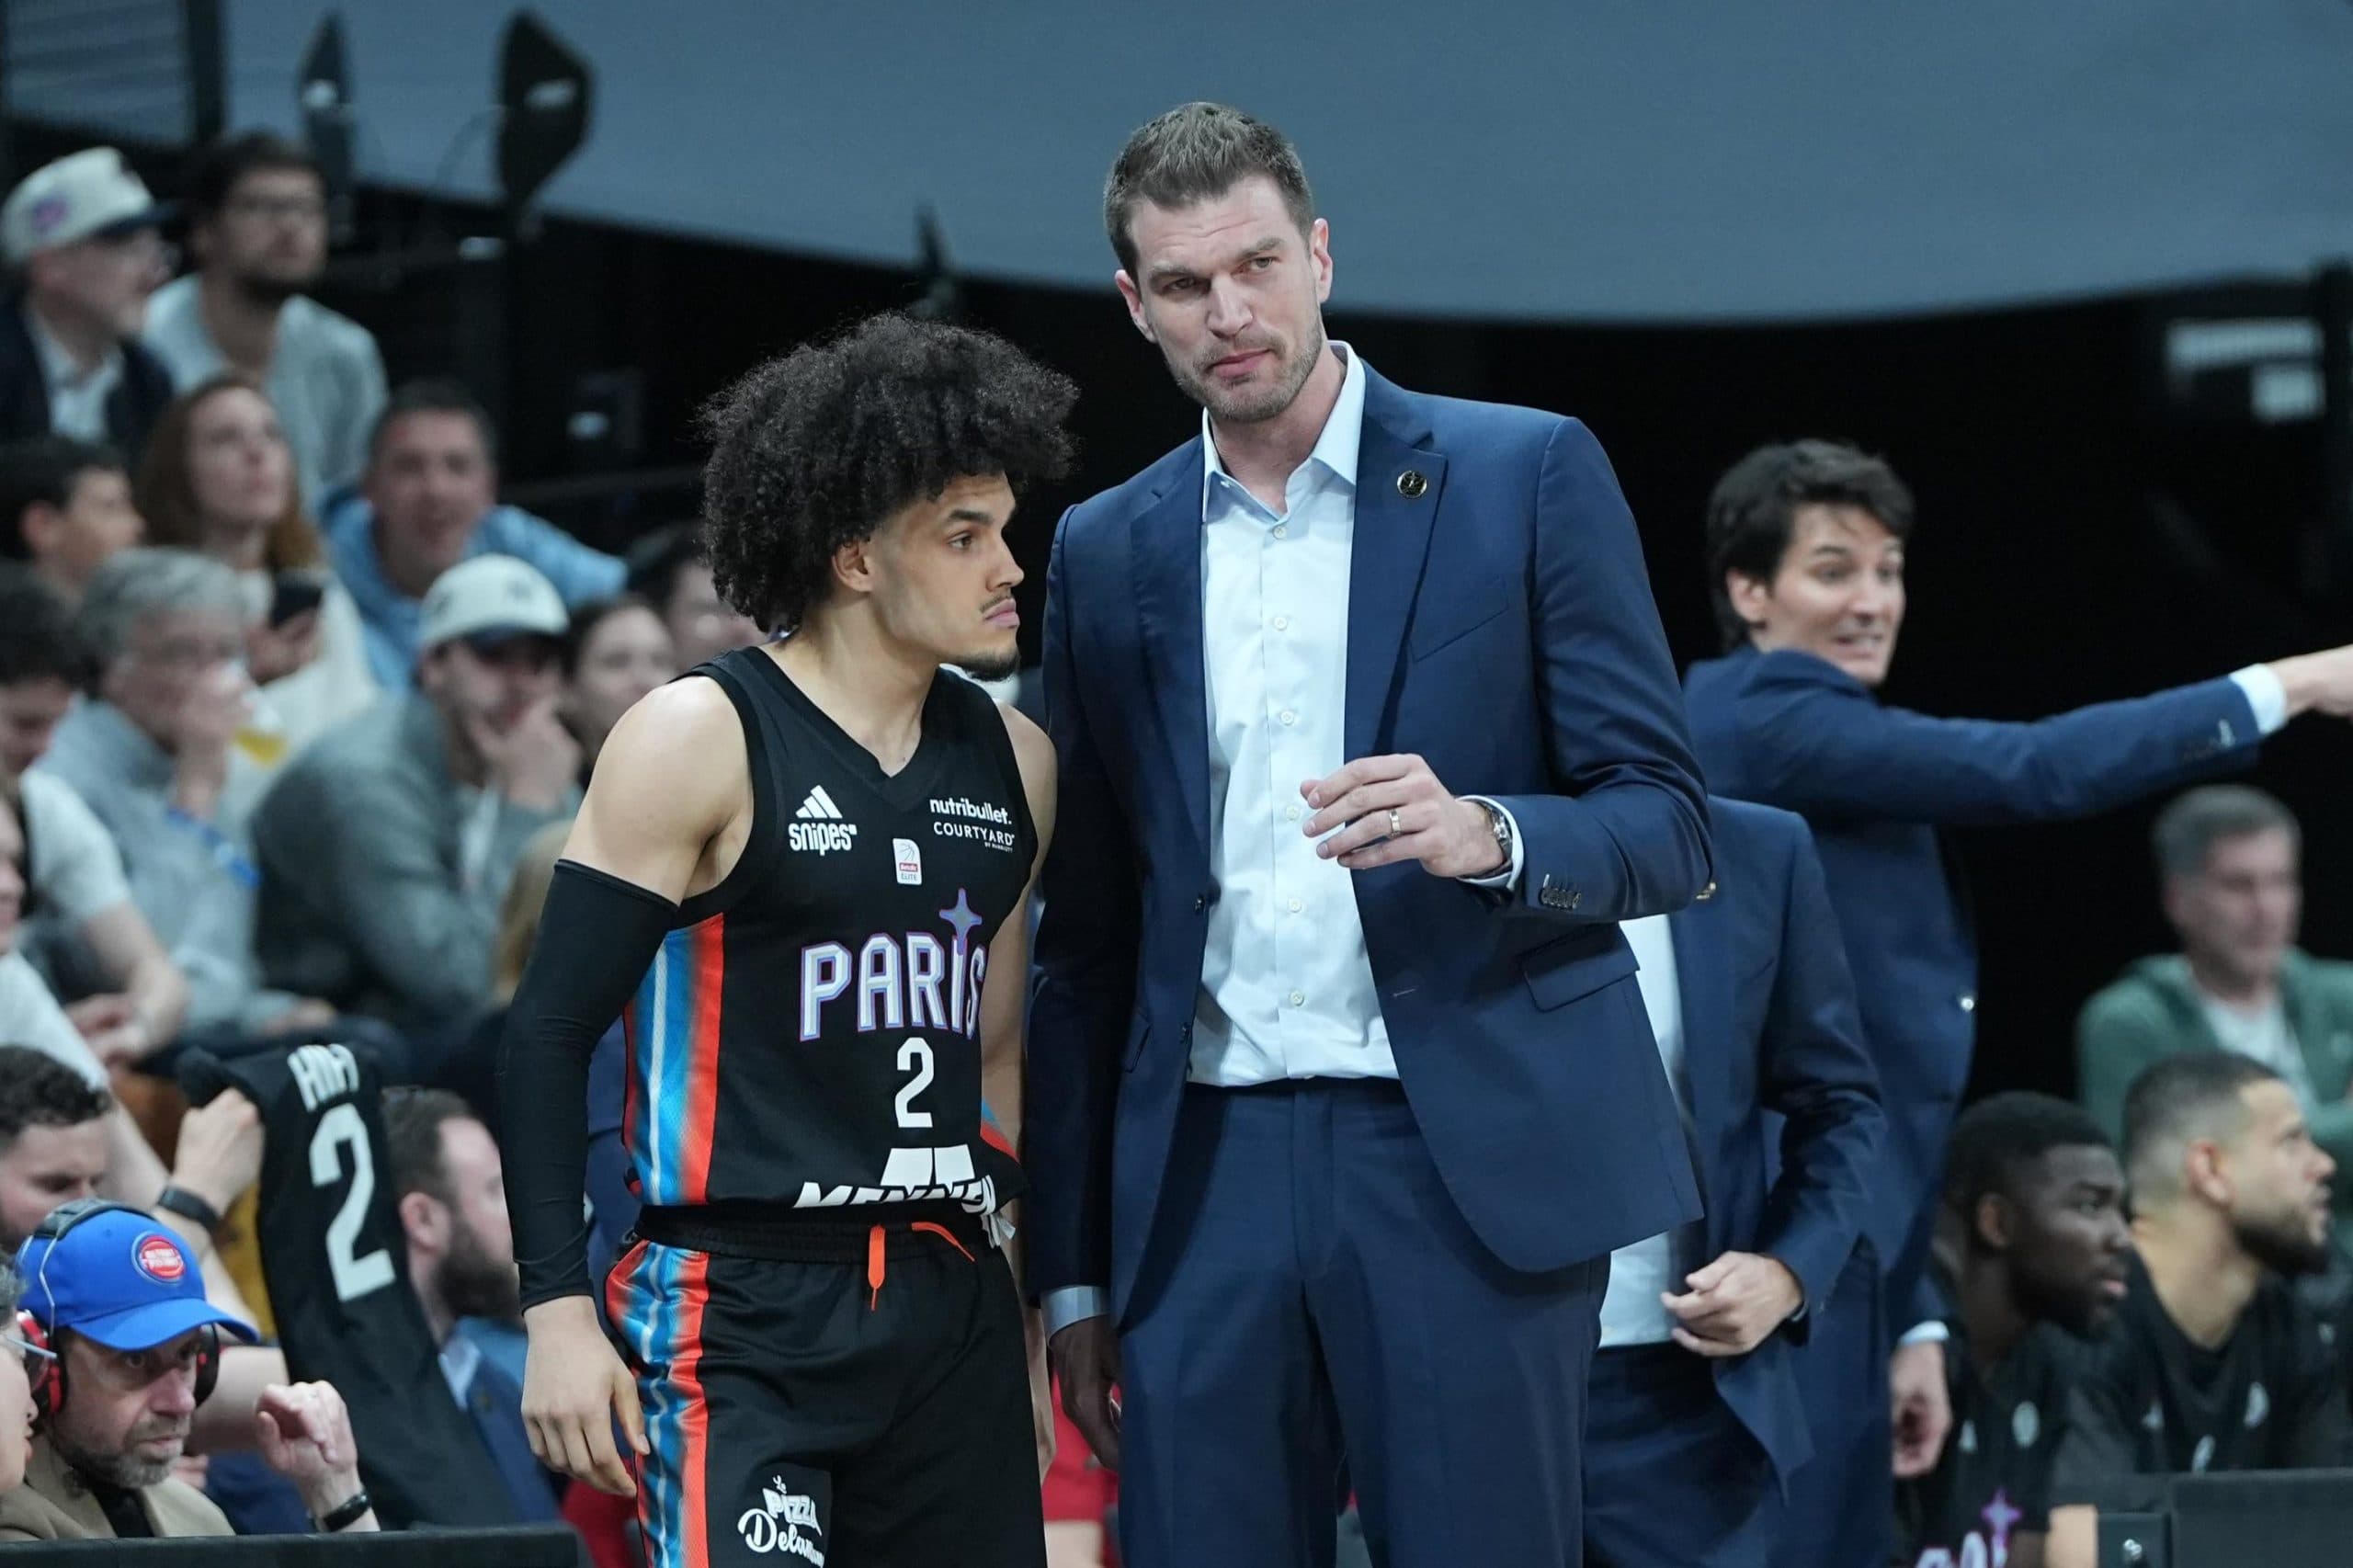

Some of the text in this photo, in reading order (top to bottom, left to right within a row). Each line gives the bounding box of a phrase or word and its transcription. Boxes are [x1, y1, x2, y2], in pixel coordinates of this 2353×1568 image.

[788, 822, 852, 857] snipes
[929, 797, 1012, 824] nutribullet.
[933, 821, 1014, 846] COURTYARD
[800, 932, 987, 1040] PARIS
[894, 1037, 935, 1129] 2
[309, 1103, 396, 1302] 2
